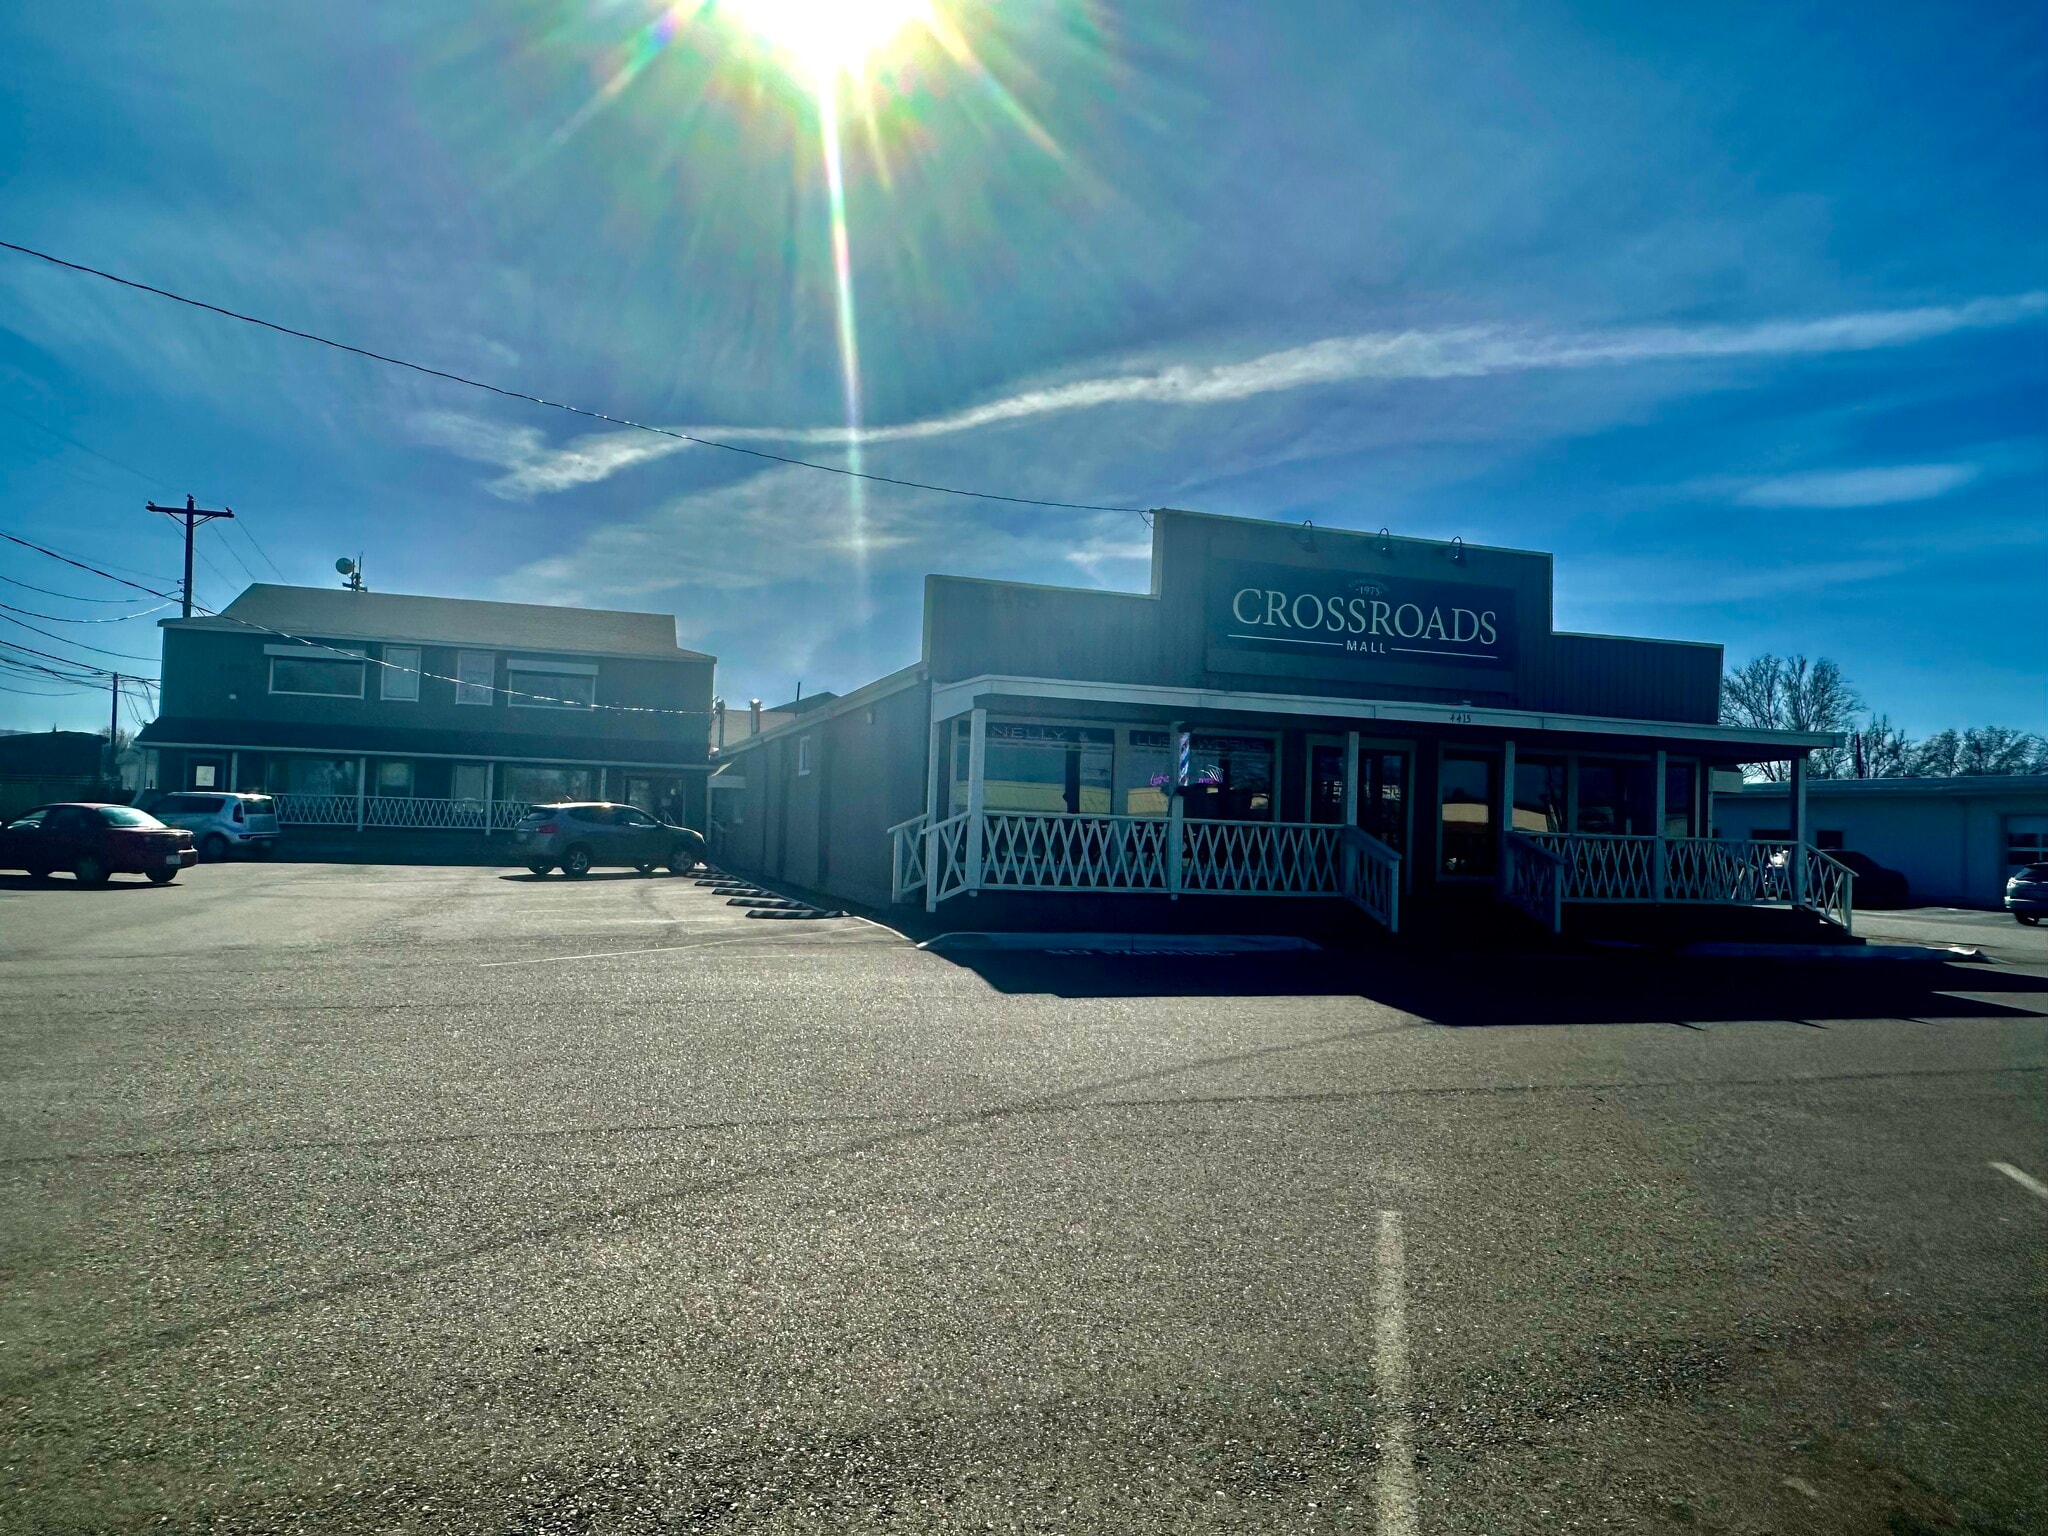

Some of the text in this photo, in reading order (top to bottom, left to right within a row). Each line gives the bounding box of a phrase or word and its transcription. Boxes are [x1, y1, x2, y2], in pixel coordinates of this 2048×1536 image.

[1232, 588, 1497, 645] CROSSROADS
[1347, 640, 1386, 654] MALL
[1450, 713, 1471, 723] 4415
[992, 727, 1066, 741] NELLY
